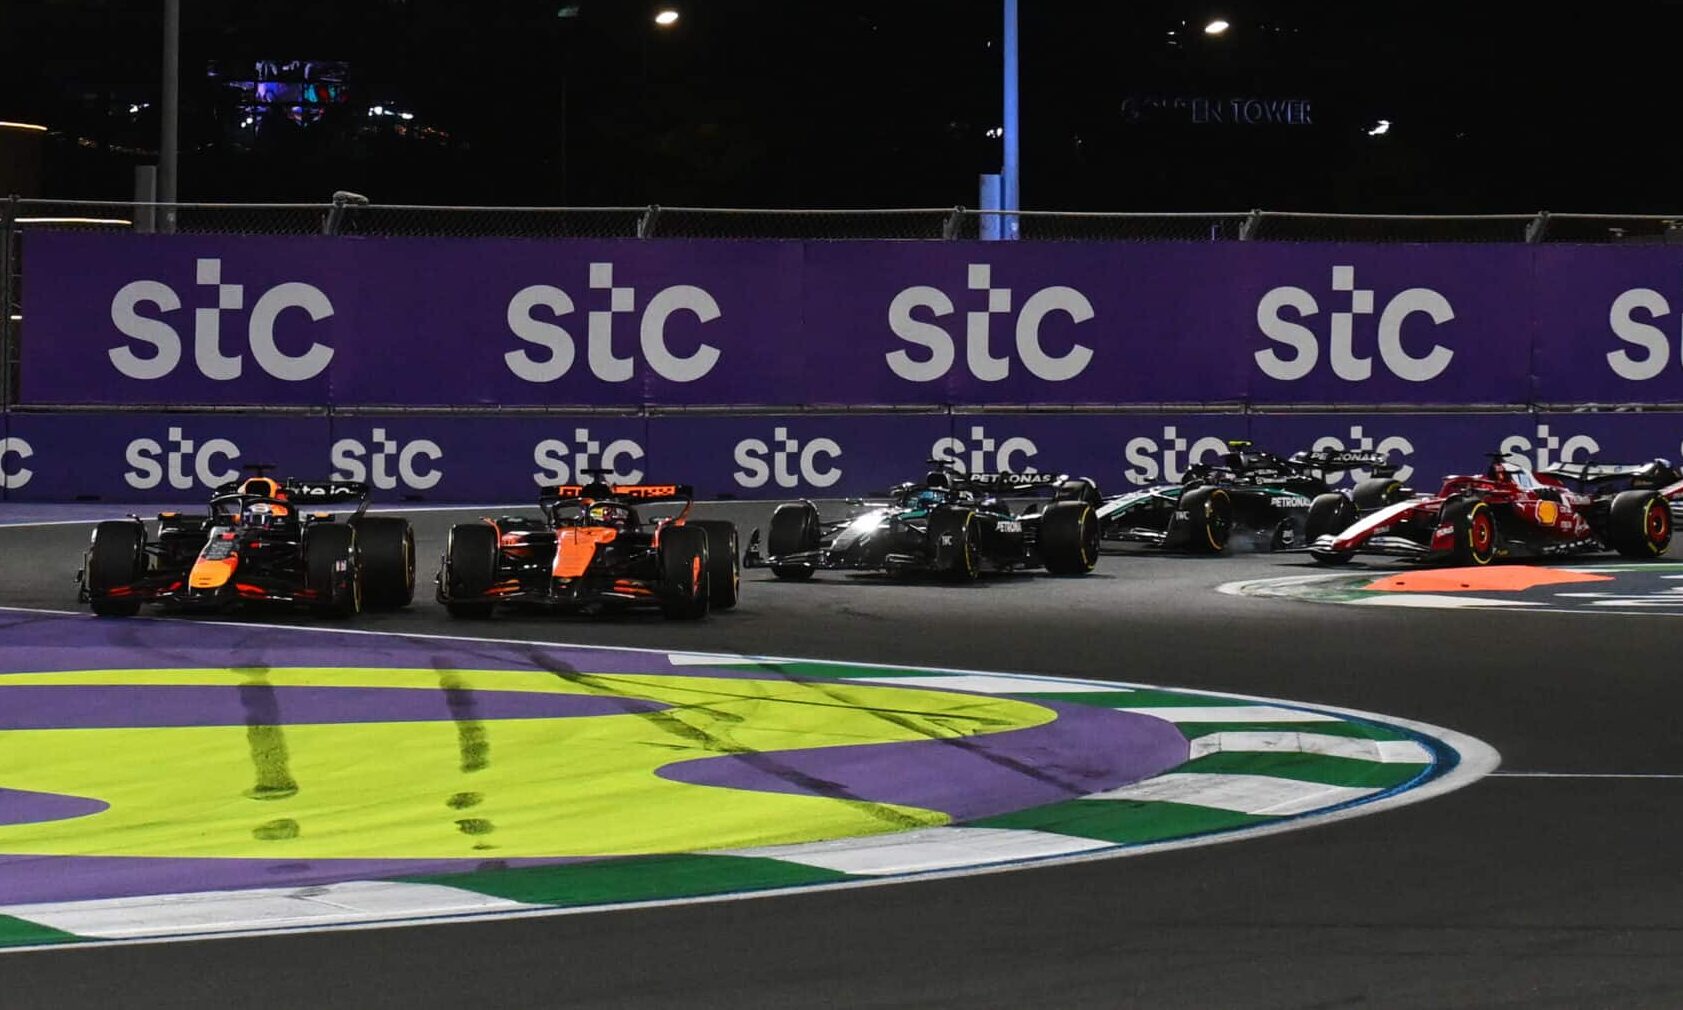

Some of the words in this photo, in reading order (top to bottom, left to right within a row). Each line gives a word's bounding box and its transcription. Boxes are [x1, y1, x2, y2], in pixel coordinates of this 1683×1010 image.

[1230, 98, 1313, 124] TOWER
[108, 258, 335, 381] stc
[504, 262, 721, 382] stc
[886, 263, 1095, 382] stc
[1255, 265, 1454, 381] stc
[1606, 288, 1683, 381] s
[124, 427, 241, 489] stc
[331, 427, 443, 489] stc
[533, 428, 645, 487] stc
[733, 427, 842, 488] stc
[969, 473, 1052, 484] PETONAS
